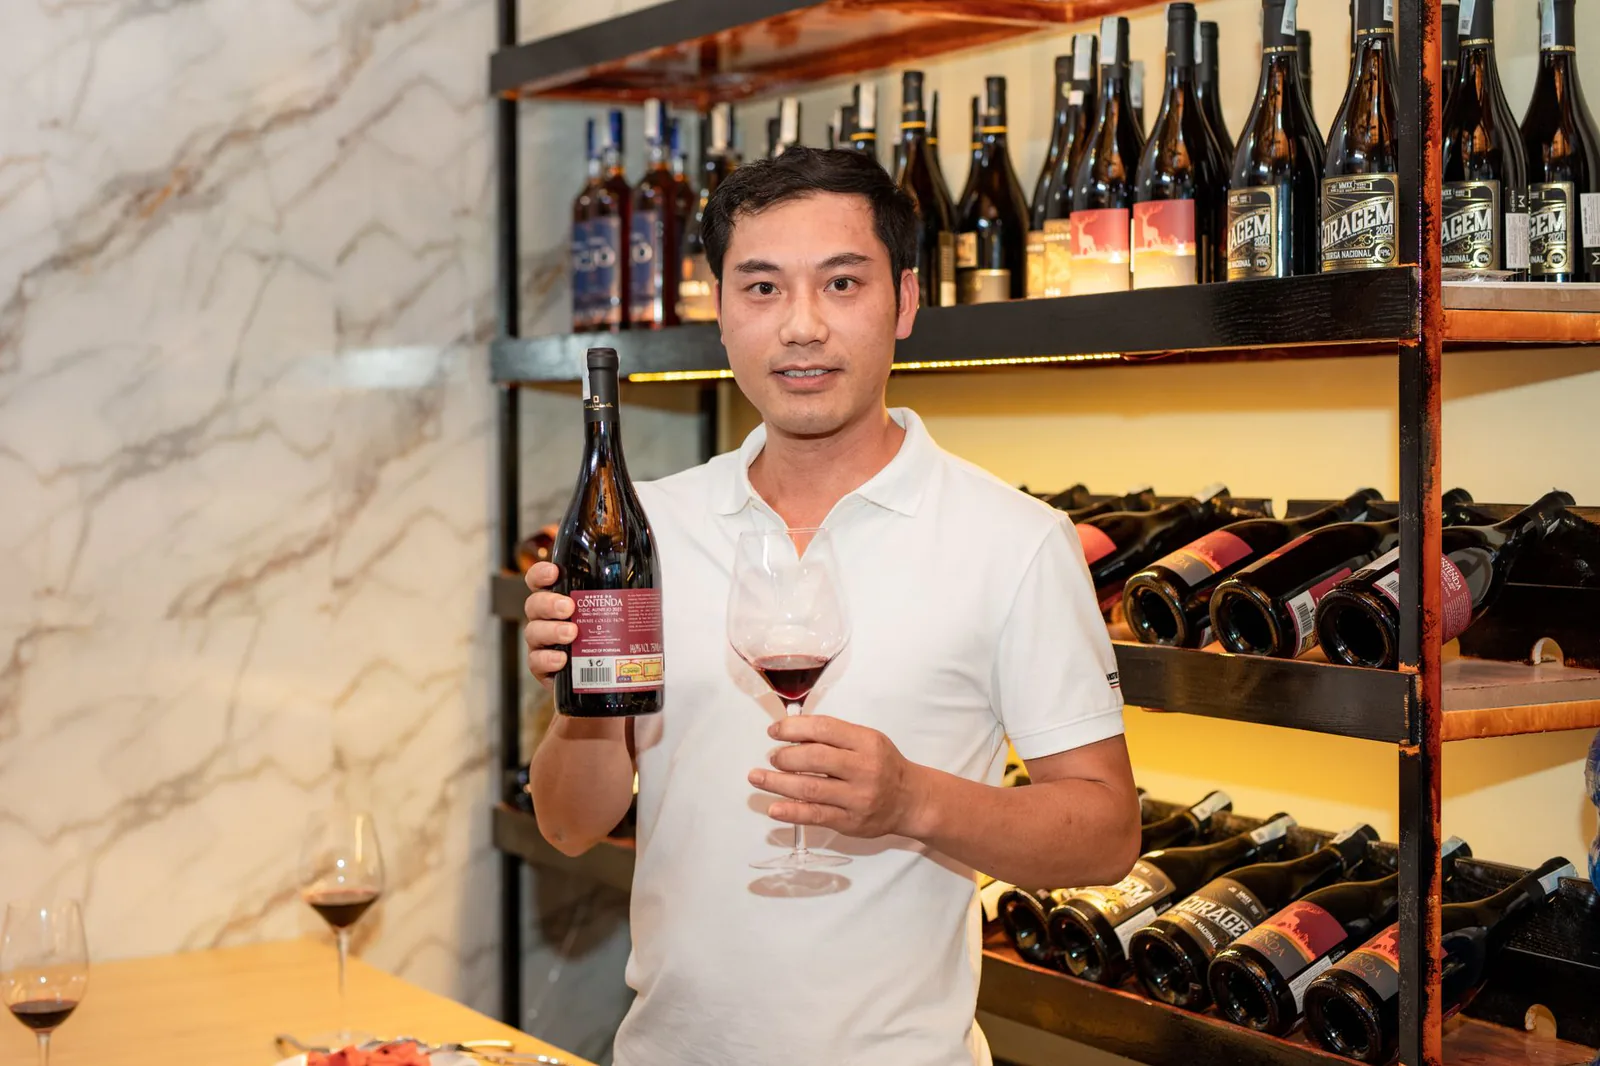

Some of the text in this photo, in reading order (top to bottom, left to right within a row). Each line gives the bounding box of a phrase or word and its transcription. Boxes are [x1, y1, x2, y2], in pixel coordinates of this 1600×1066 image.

[1375, 224, 1393, 236] 2020
[1474, 229, 1492, 241] 2020
[1254, 234, 1270, 247] 2020
[1548, 231, 1565, 242] 2020
[1341, 249, 1371, 259] NACIONAL
[577, 598, 624, 608] CONTENDA
[1178, 894, 1254, 939] CORAGE
[1196, 920, 1219, 949] NACIONAL
